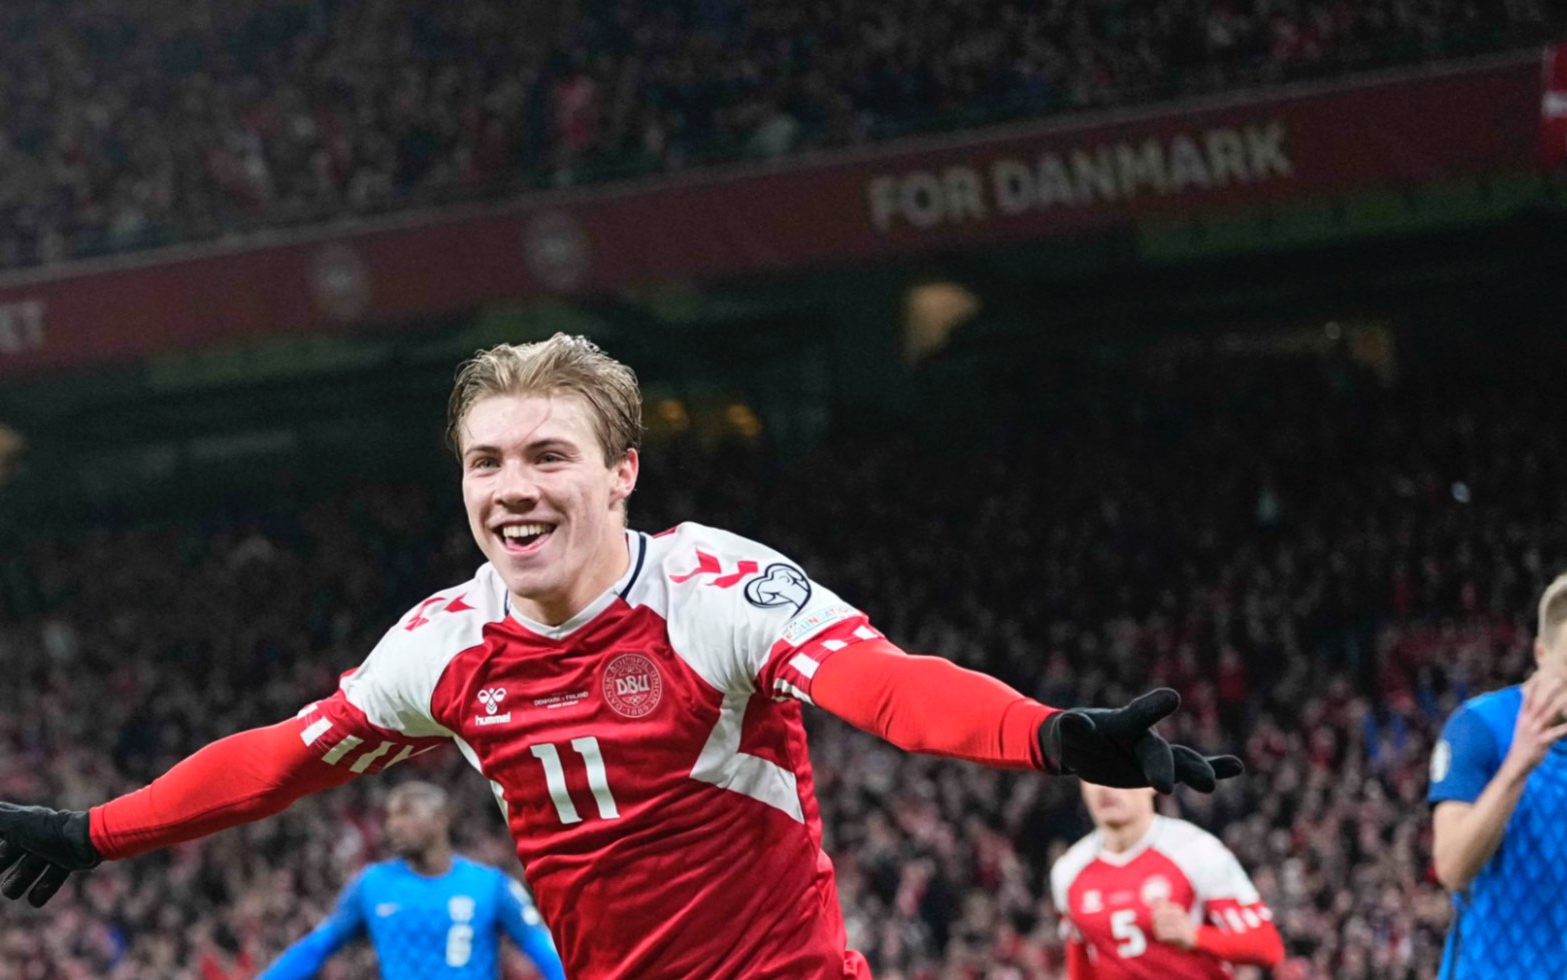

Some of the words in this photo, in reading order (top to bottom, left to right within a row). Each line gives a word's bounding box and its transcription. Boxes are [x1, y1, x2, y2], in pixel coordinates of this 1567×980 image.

[867, 165, 985, 229] FOR
[990, 123, 1293, 215] DANMARK
[615, 674, 650, 696] DBU
[475, 712, 511, 726] hummel
[530, 736, 622, 824] 11
[446, 924, 474, 967] 6
[1111, 909, 1147, 958] 5
